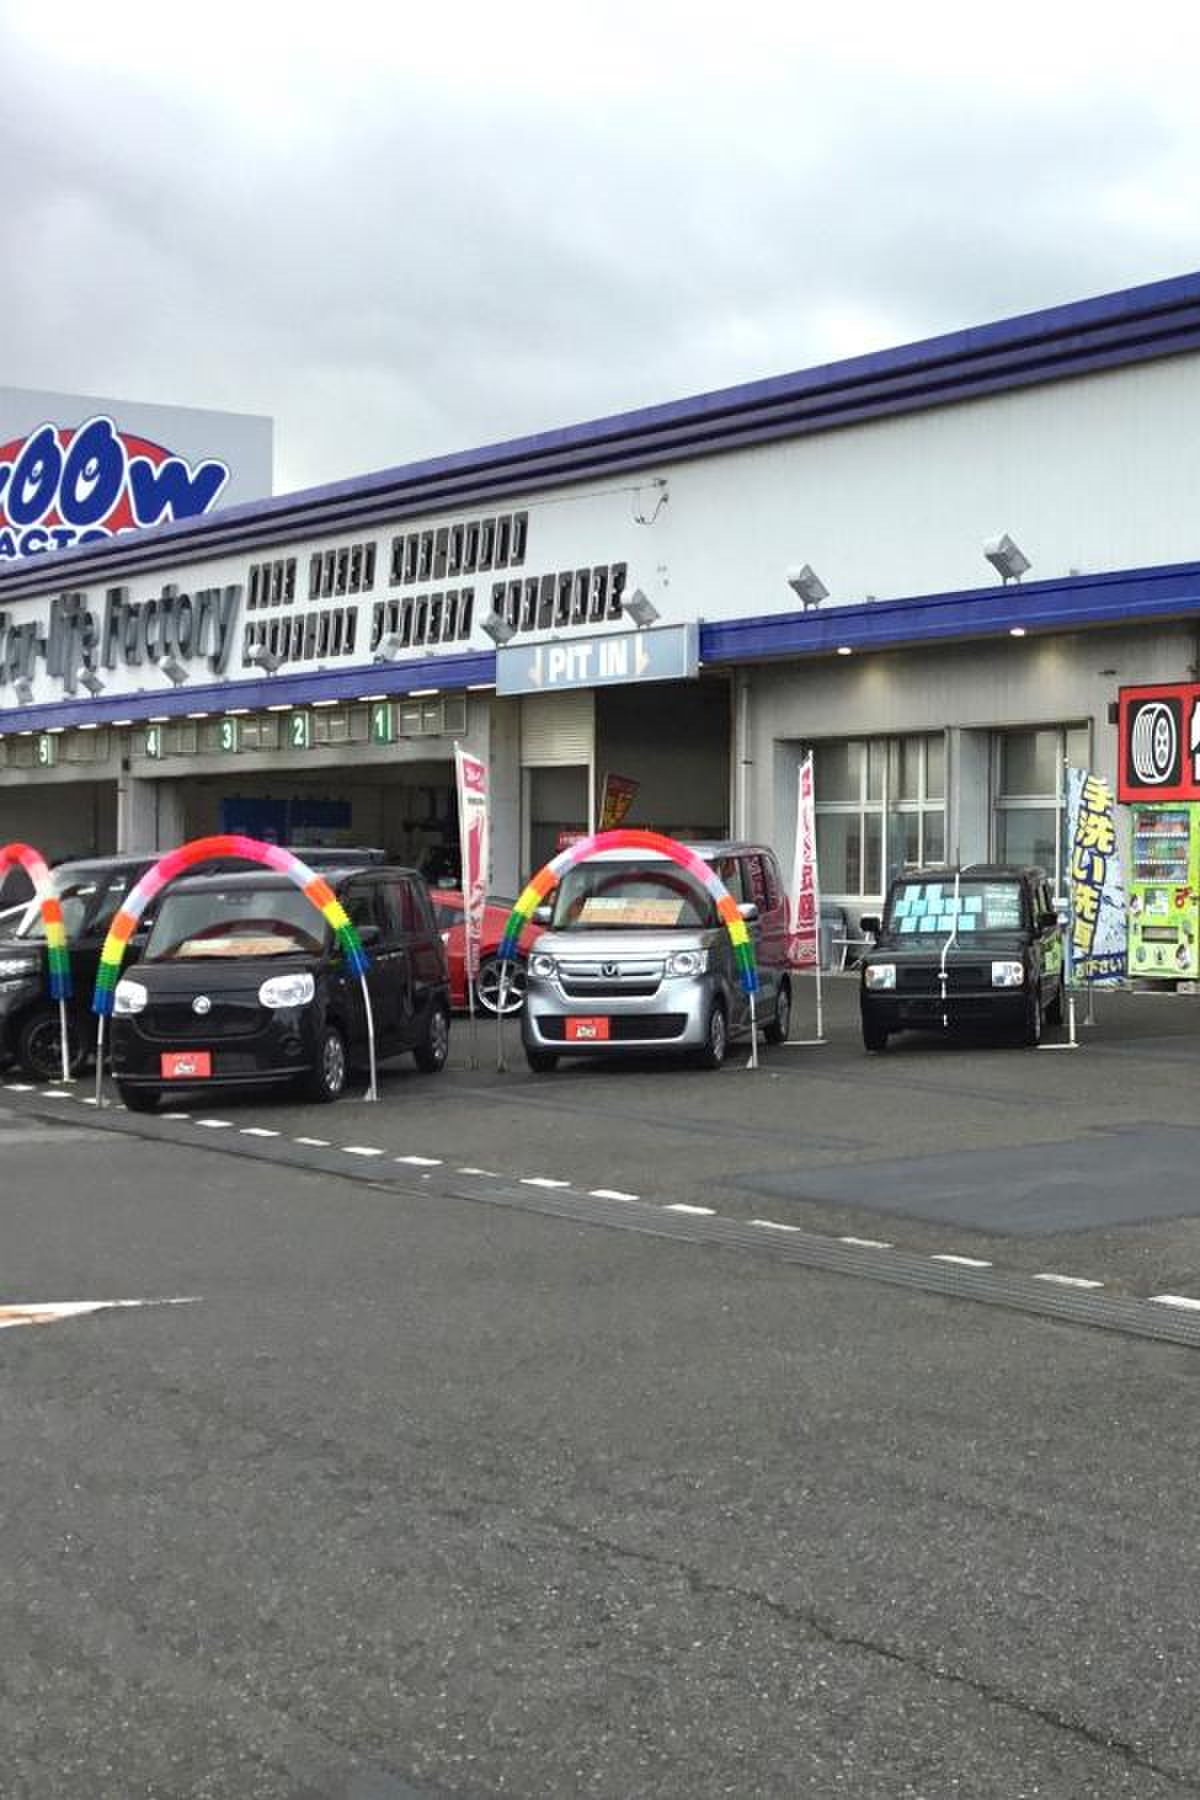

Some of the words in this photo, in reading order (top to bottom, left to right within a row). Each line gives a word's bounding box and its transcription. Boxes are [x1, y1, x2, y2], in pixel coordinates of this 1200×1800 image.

[549, 643, 592, 683] PIT
[599, 639, 629, 678] IN
[294, 717, 303, 743] 2
[375, 710, 384, 736] 1
[147, 731, 156, 754] 4
[223, 724, 232, 749] 3
